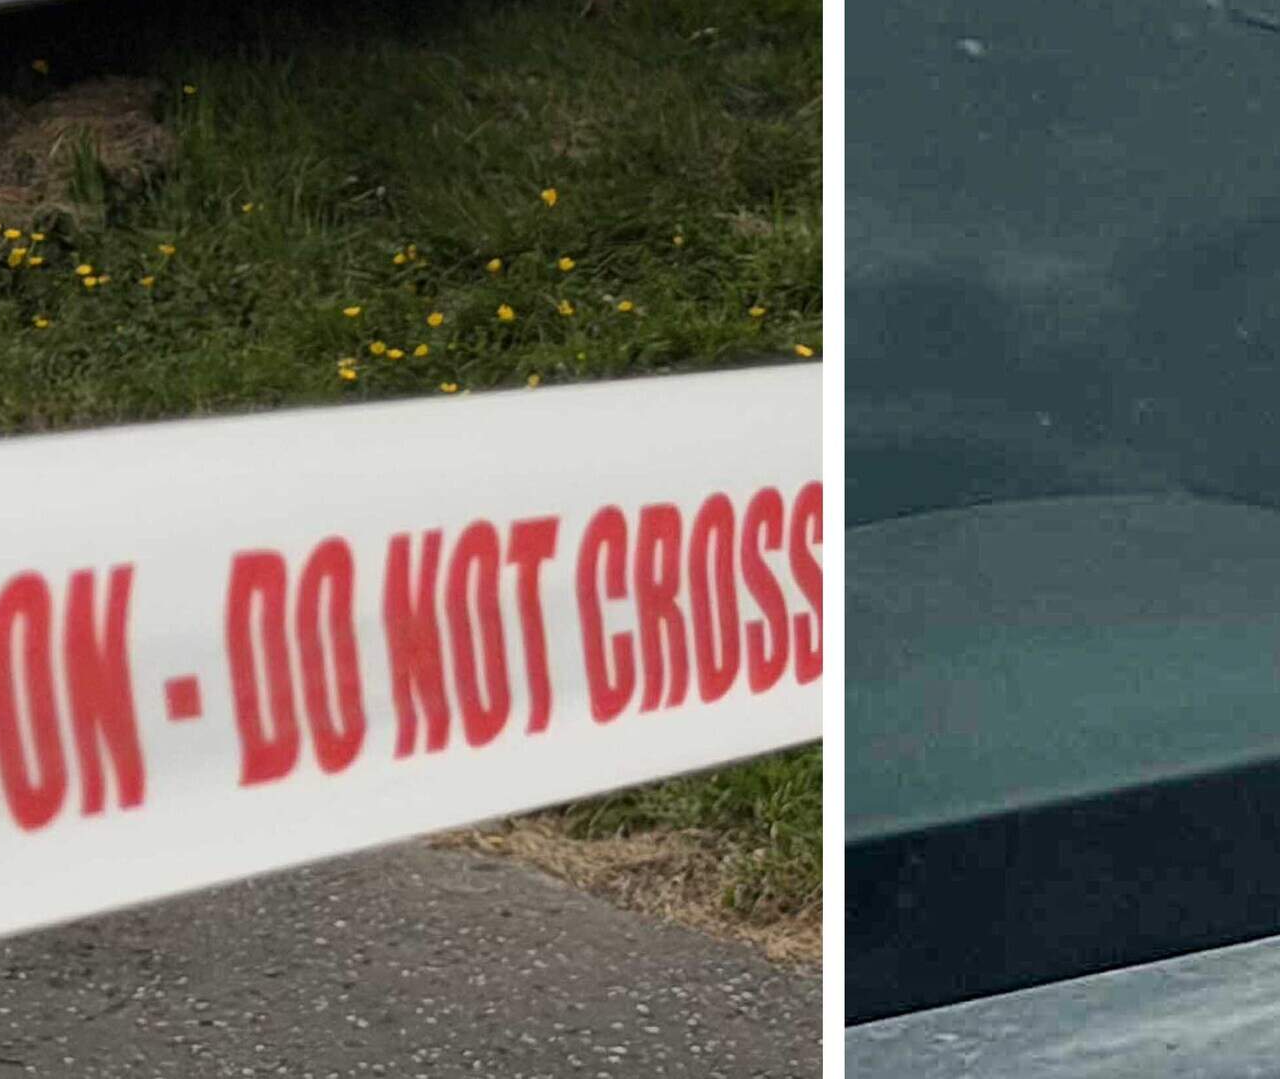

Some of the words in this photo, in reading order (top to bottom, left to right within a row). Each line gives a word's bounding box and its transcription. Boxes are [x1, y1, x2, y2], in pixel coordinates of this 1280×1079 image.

[225, 537, 367, 788] DO
[383, 515, 560, 760] NOT
[575, 481, 823, 725] CROSS
